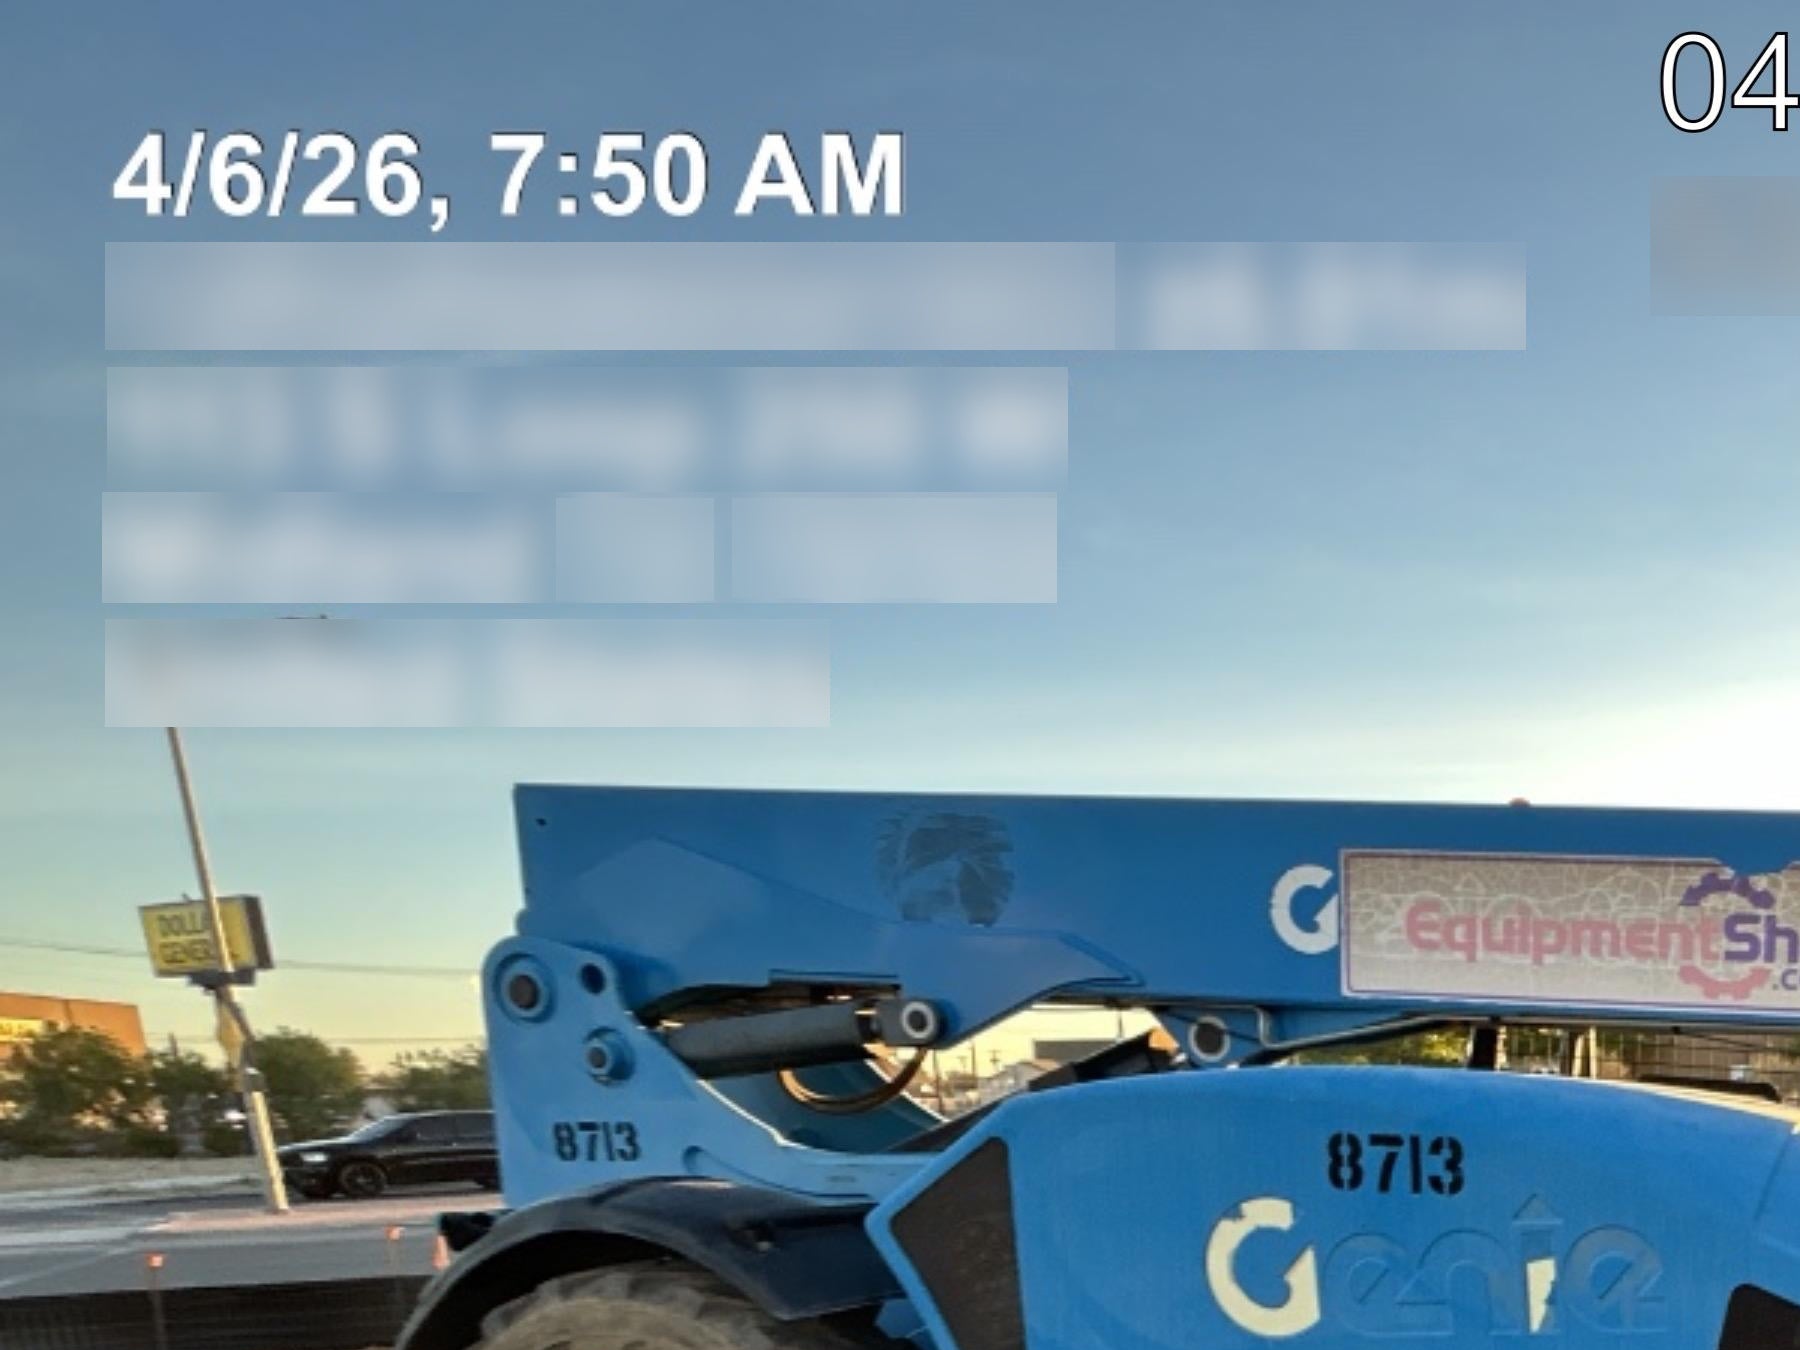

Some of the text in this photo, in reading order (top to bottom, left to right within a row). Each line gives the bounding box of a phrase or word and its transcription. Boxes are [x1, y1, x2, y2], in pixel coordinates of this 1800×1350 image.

[553, 1121, 642, 1162] 8713
[1327, 1132, 1464, 1196] 8713
[1205, 1193, 1668, 1337] Genie
